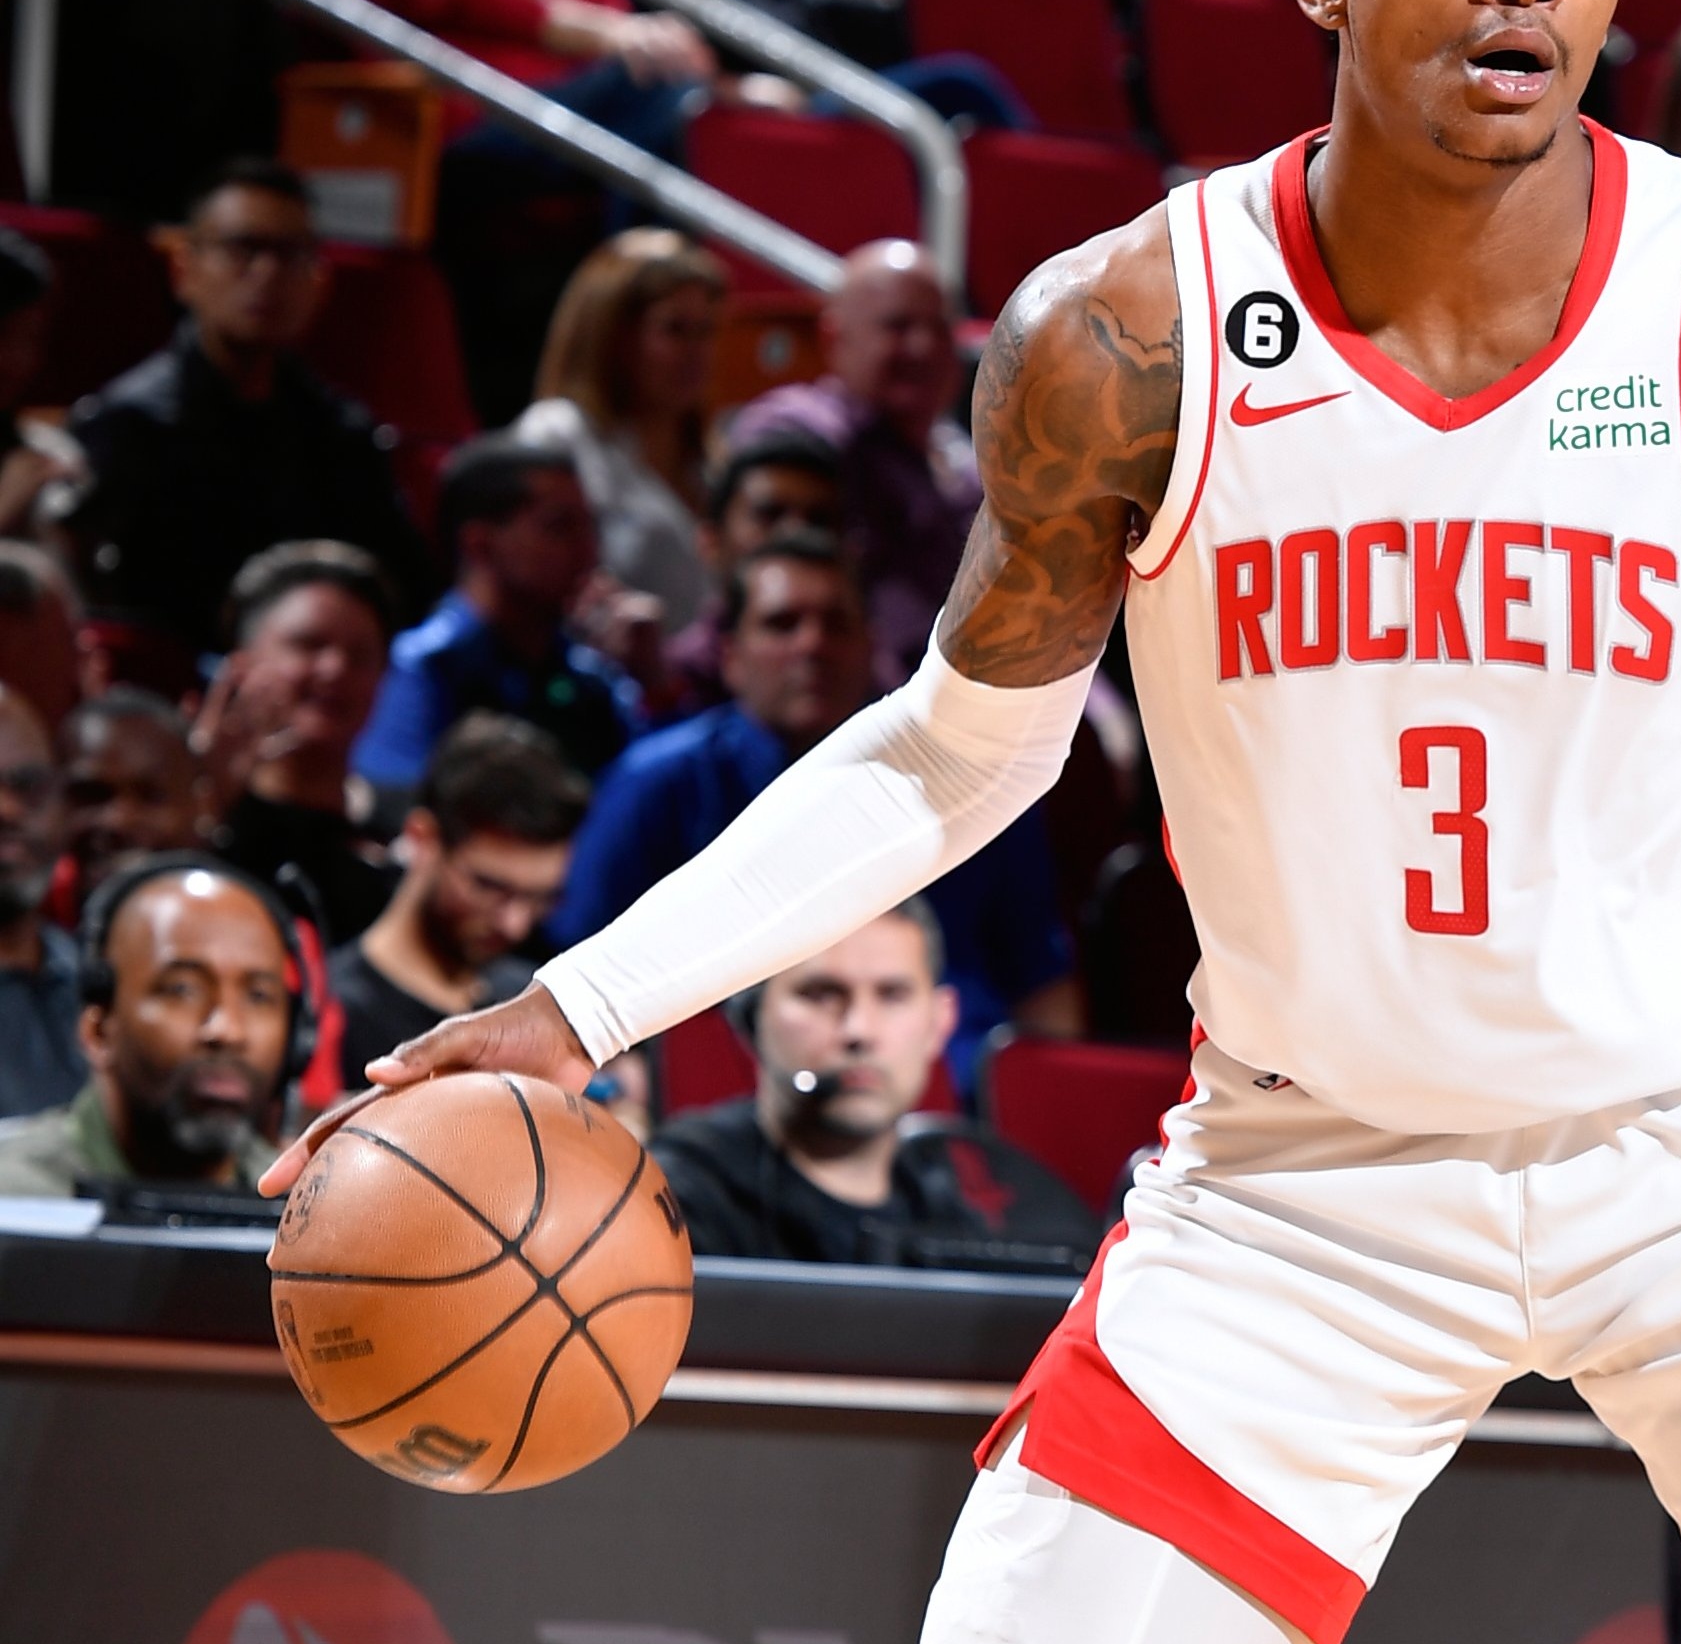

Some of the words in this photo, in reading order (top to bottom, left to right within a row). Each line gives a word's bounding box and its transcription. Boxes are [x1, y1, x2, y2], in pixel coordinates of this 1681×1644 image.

[1241, 301, 1283, 360] 6
[1556, 374, 1663, 413] credit
[1549, 418, 1671, 451] karma
[1213, 519, 1680, 685] ROCKETS
[1399, 725, 1490, 937] 3
